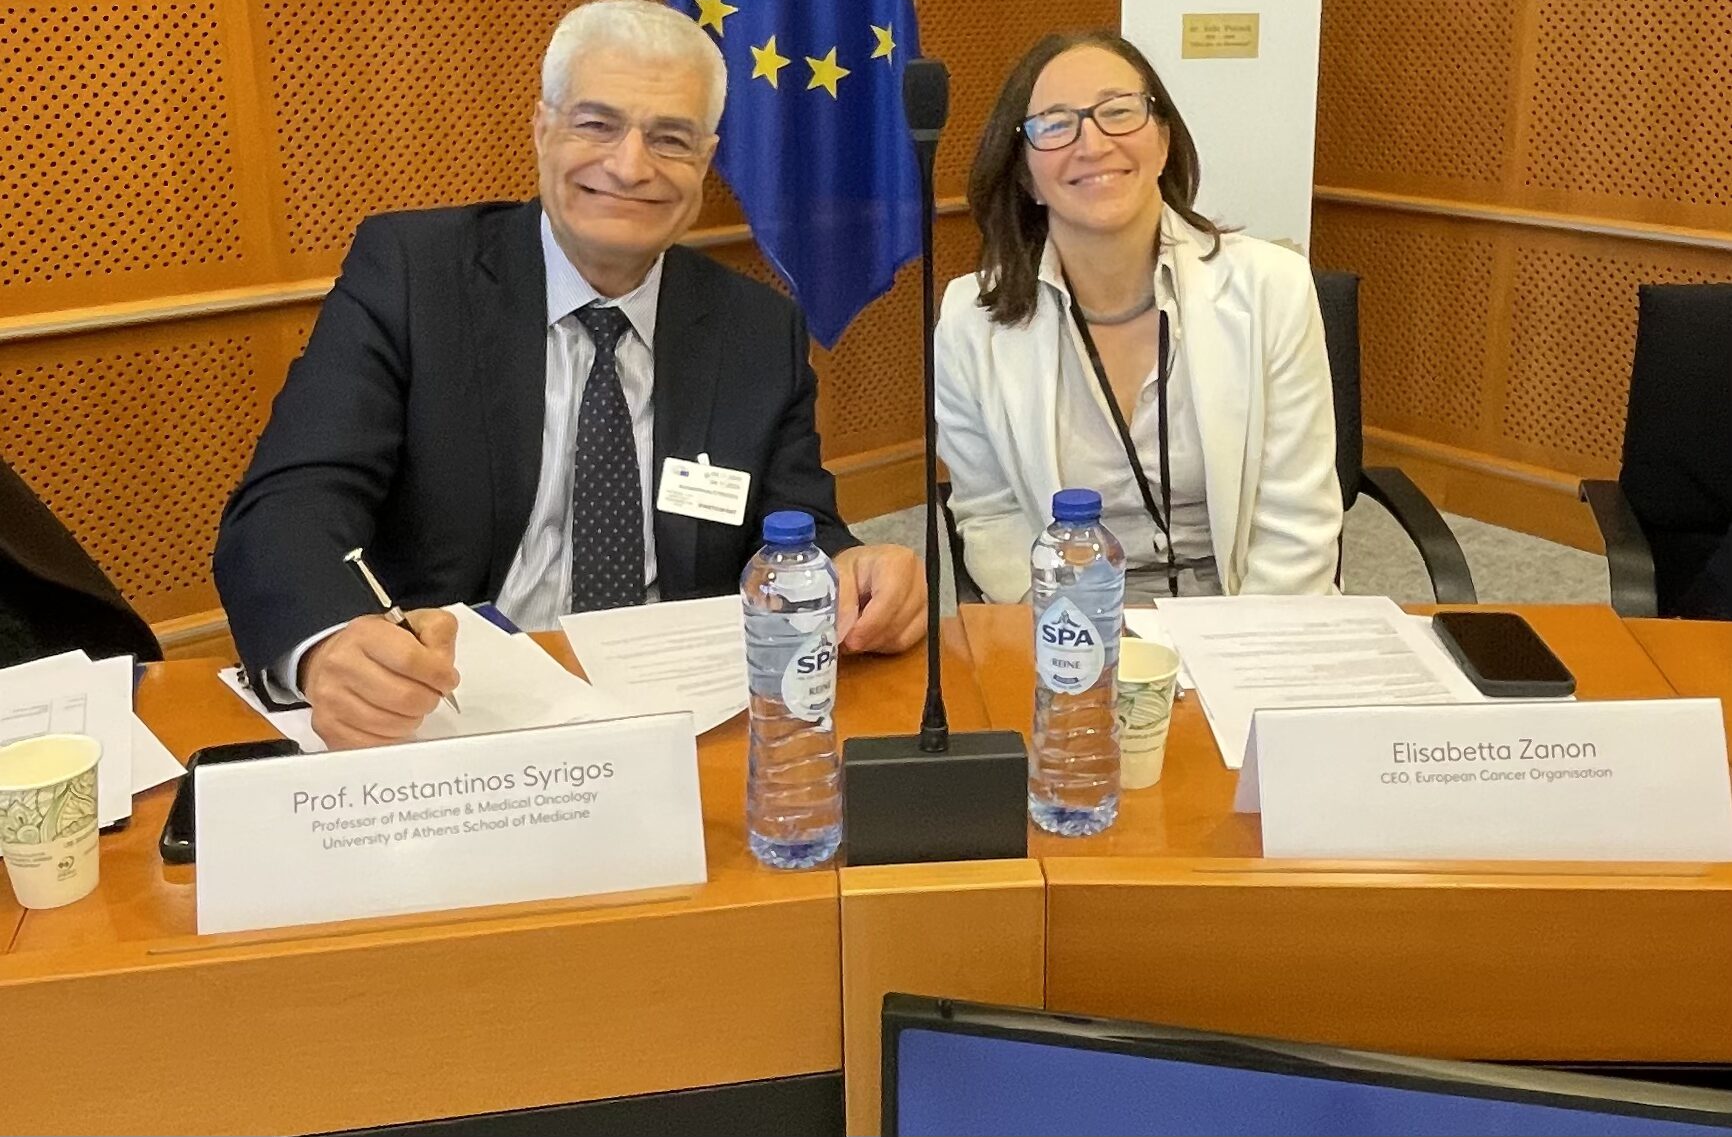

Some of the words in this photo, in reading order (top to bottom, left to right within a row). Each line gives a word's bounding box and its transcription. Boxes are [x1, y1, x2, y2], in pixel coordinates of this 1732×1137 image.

[1042, 624, 1094, 647] SPA
[1393, 740, 1511, 764] Elisabetta
[1519, 738, 1596, 760] Zanon
[293, 786, 353, 815] Prof.
[364, 772, 516, 806] Kostantinos
[523, 760, 614, 790] Syrigos
[1416, 770, 1476, 784] European
[1480, 768, 1525, 781] Cancer
[1530, 766, 1612, 782] Organisation
[312, 816, 377, 833] Professor
[381, 812, 394, 825] of
[398, 803, 461, 822] Medicine
[464, 803, 474, 814] &
[478, 795, 531, 813] Medical
[534, 789, 598, 808] Oncology
[322, 831, 390, 849] University
[394, 827, 408, 841] of
[412, 822, 460, 839] Athens
[463, 817, 509, 833] School
[512, 813, 526, 827] of
[530, 808, 590, 824] Medicine
